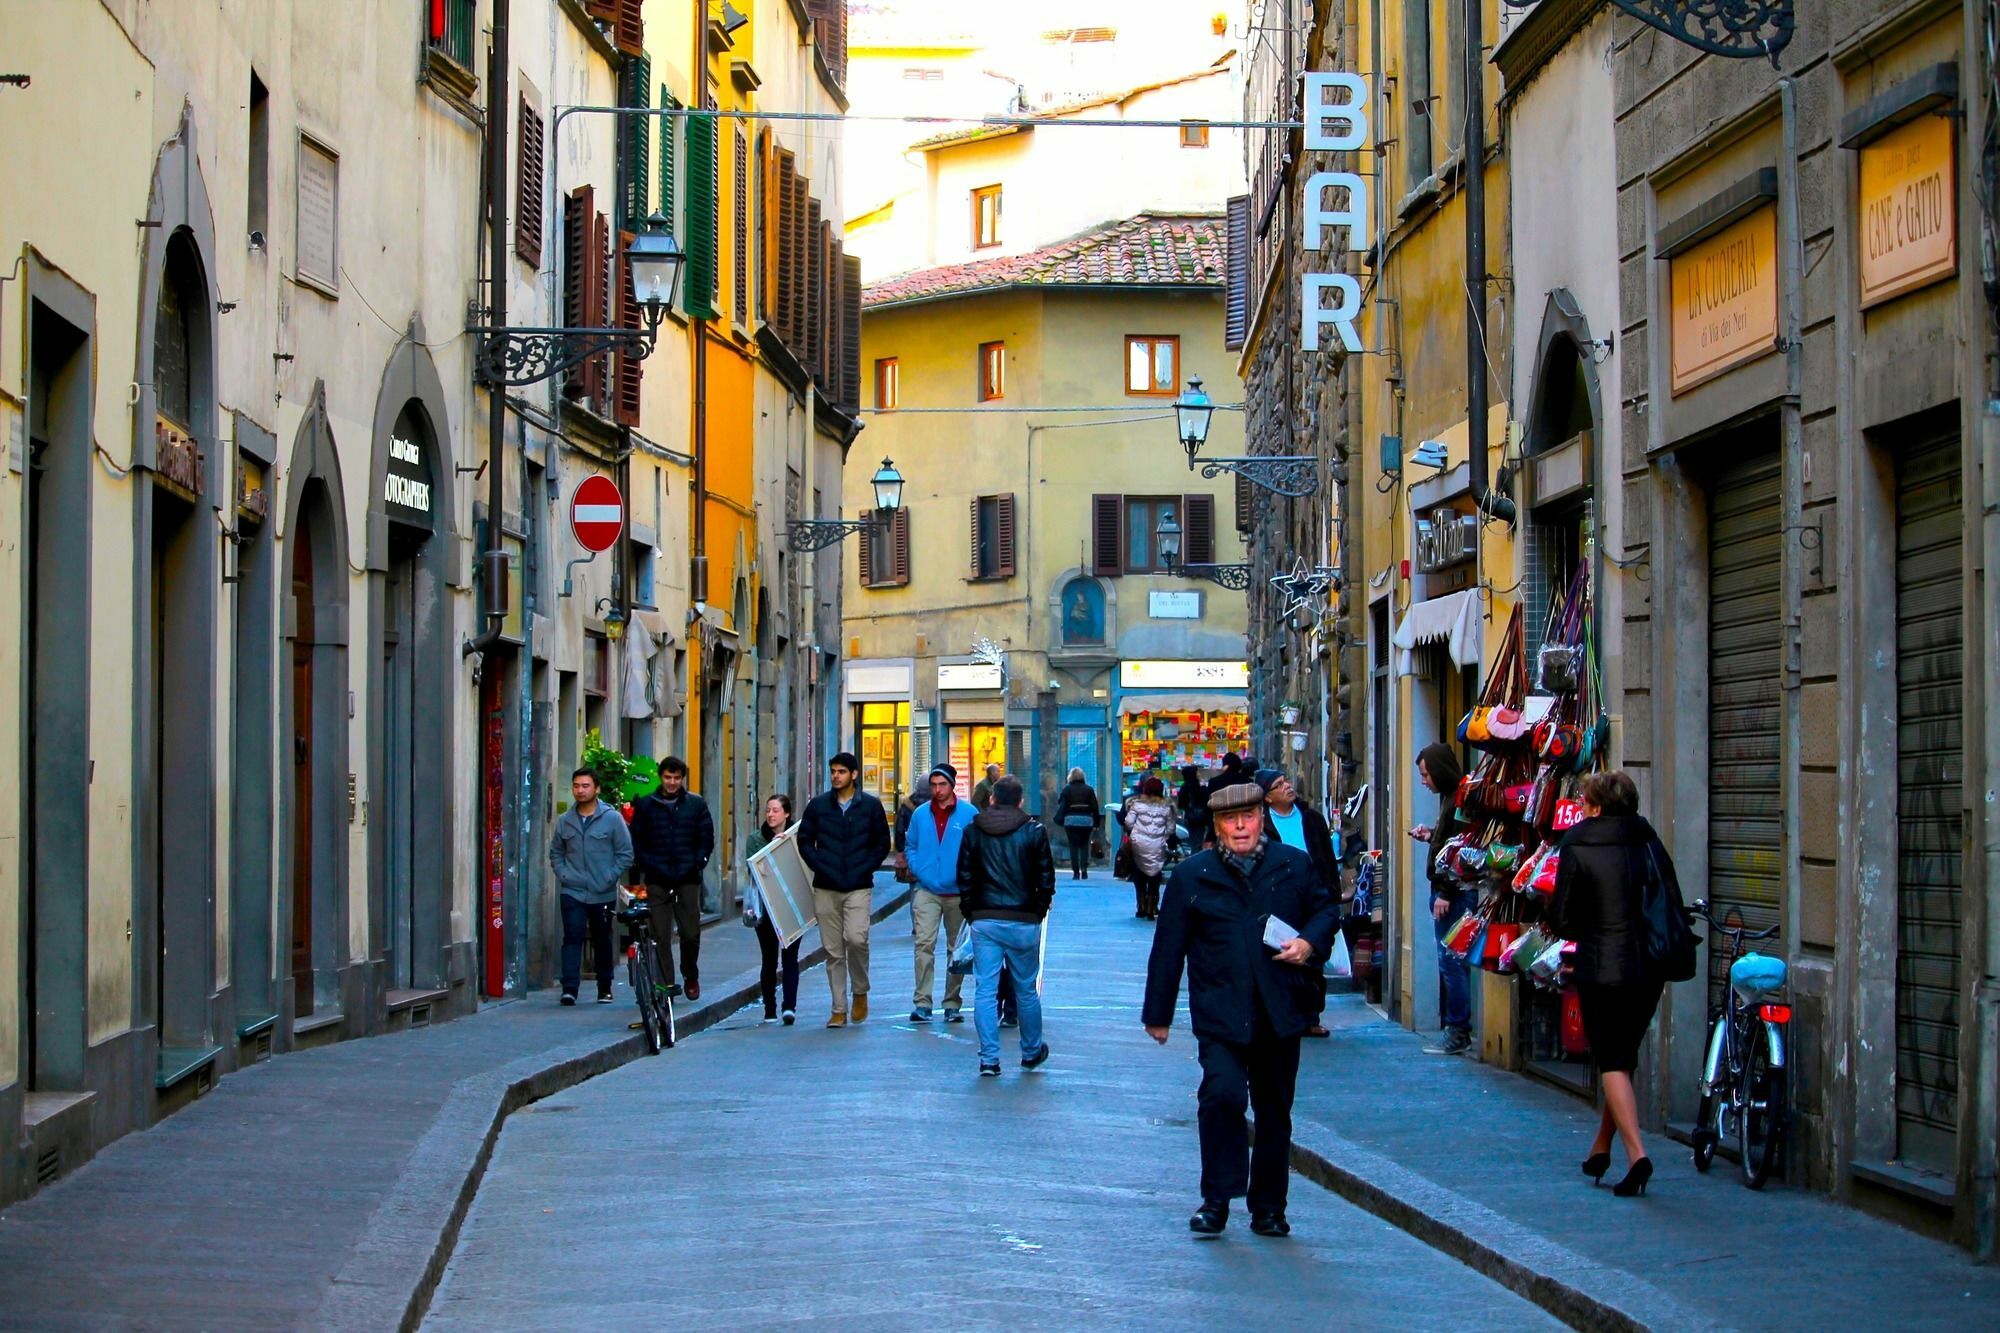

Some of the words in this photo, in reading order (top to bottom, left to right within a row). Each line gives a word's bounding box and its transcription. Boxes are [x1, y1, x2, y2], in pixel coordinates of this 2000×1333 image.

[1882, 151, 1904, 179] tutto
[1906, 143, 1921, 173] per
[1301, 71, 1368, 353] BAR
[1868, 196, 1893, 260] CANE
[1896, 204, 1903, 249] e
[1905, 171, 1943, 243] GATTO
[1687, 263, 1702, 320] LA
[1704, 233, 1758, 311] CUOIERIA
[1701, 325, 1708, 348] di
[1708, 322, 1719, 343] Via
[1721, 315, 1731, 338] dei
[1733, 307, 1748, 333] Neri
[1558, 805, 1583, 825] 15,0
